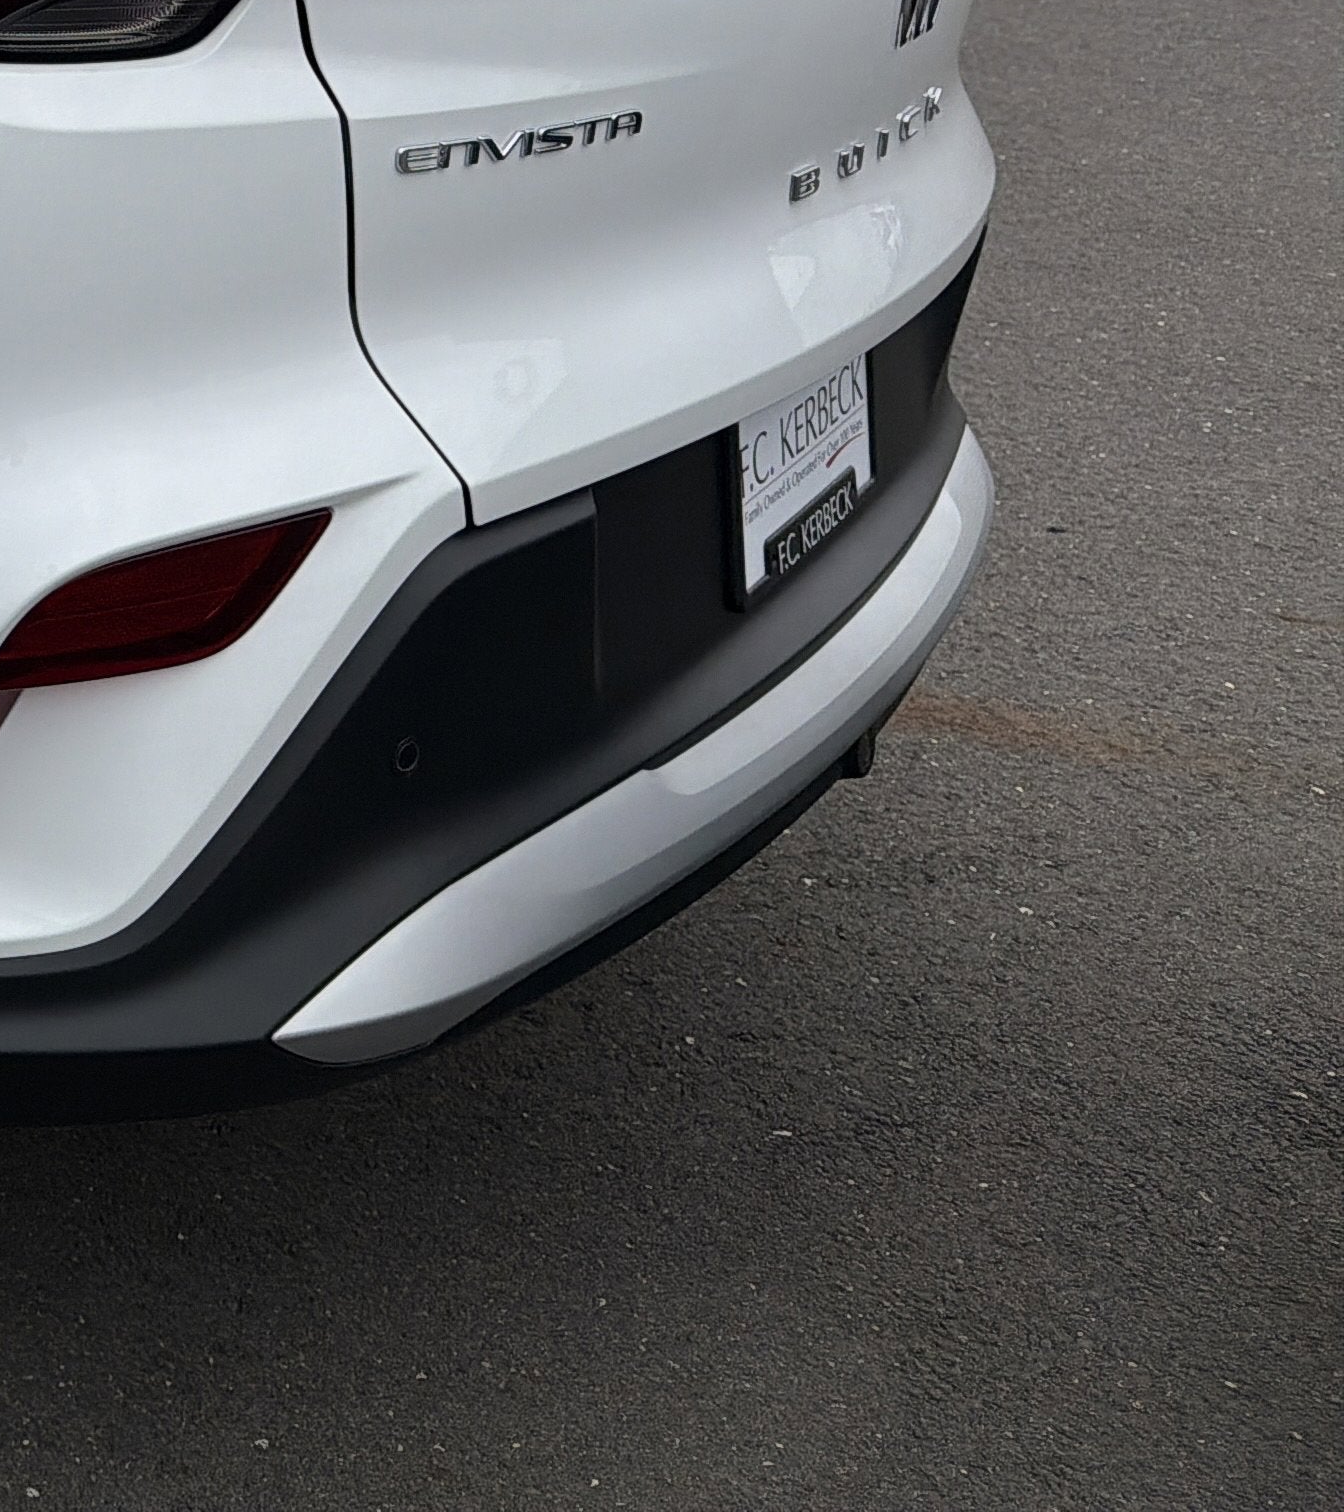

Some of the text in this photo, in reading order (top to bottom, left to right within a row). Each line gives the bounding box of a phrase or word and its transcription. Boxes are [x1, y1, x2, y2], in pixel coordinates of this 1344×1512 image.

[395, 110, 644, 175] ENVISTA
[789, 86, 944, 202] BUICK
[779, 354, 865, 467] KERBECK
[764, 481, 786, 510] Owned
[792, 453, 817, 487] Operated
[801, 479, 854, 555] KERBECK
